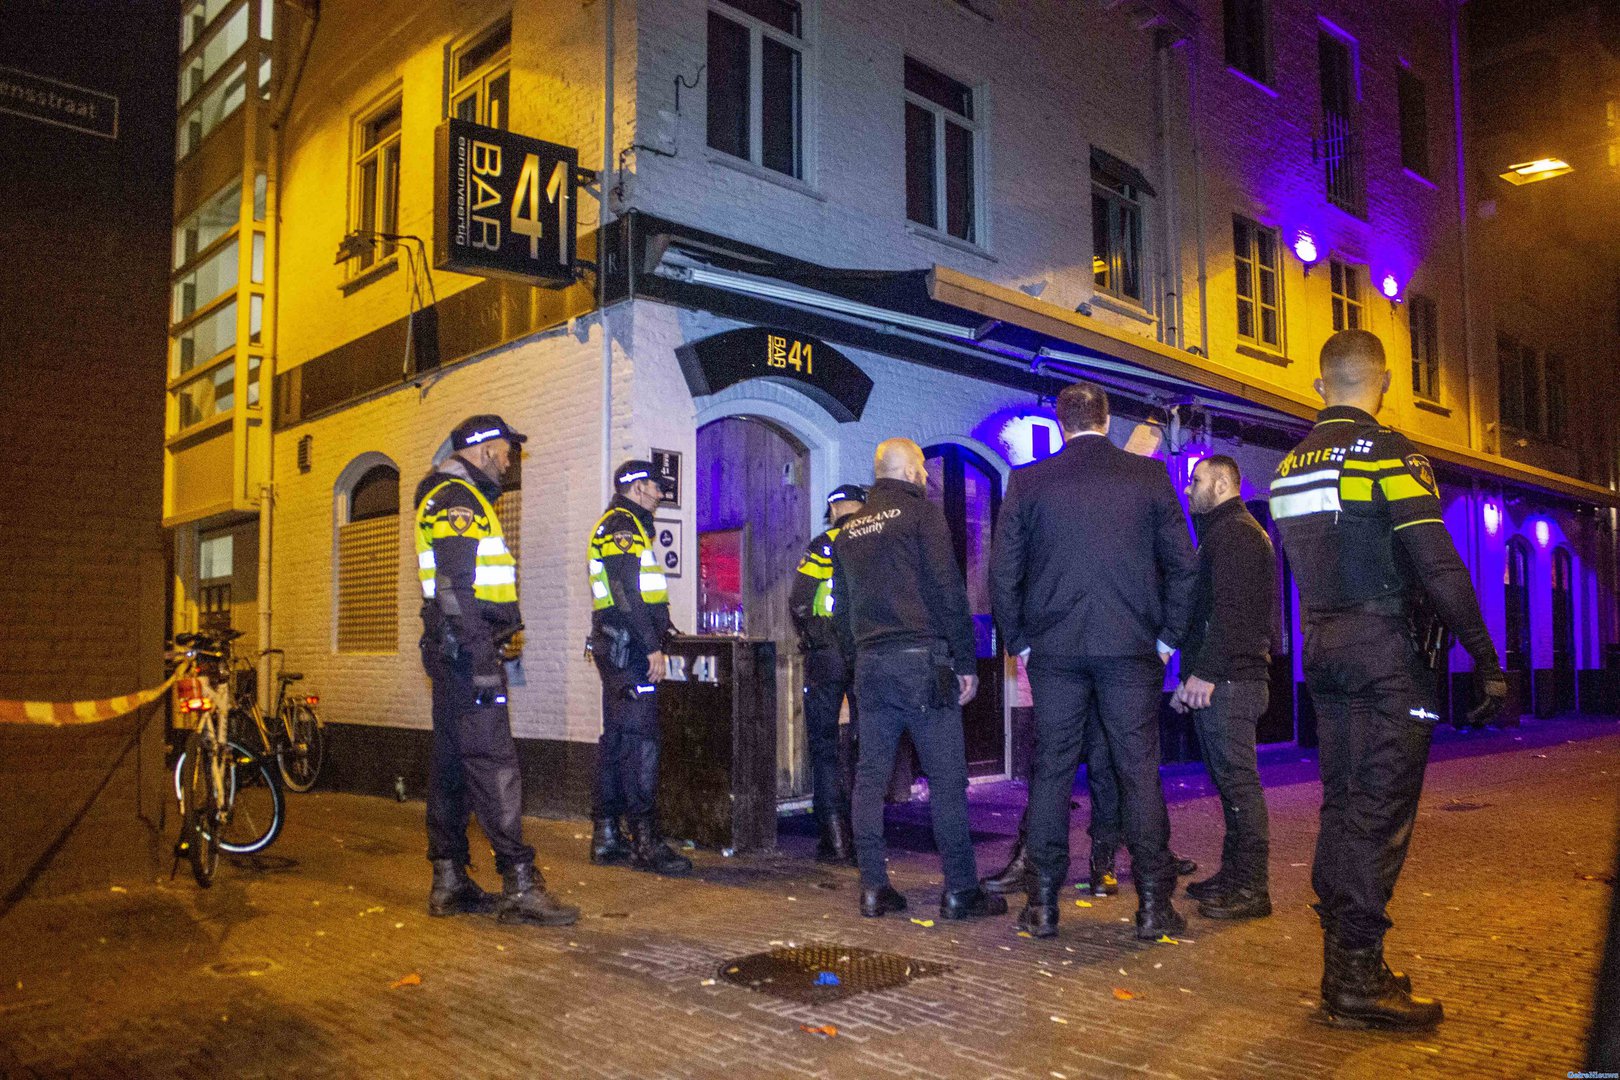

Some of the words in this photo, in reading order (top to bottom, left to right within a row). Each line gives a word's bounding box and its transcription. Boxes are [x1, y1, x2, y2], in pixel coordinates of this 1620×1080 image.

[455, 136, 466, 246] eenenveertig
[472, 139, 502, 251] BAR
[511, 153, 568, 265] 41
[773, 336, 787, 369] BAR
[788, 340, 813, 374] 41
[848, 521, 884, 539] Security
